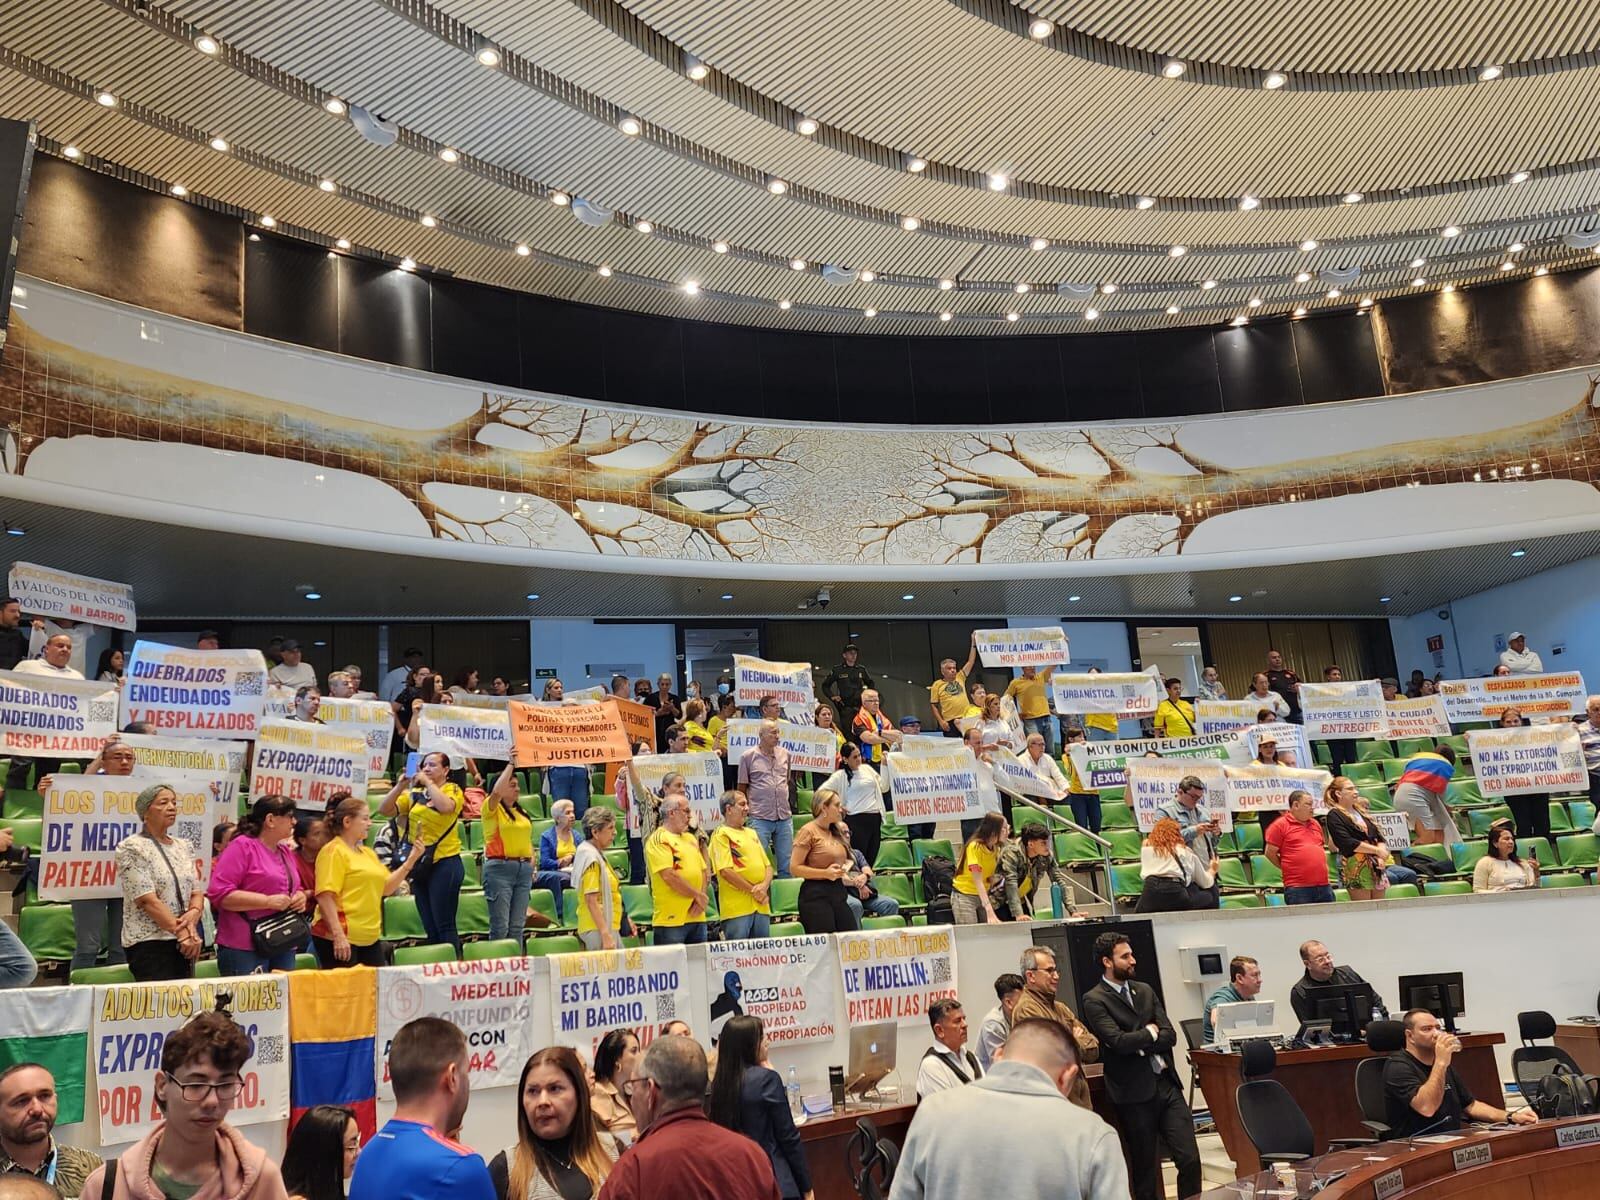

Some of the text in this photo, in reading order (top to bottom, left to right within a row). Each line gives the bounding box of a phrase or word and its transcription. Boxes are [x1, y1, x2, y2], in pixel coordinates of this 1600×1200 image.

[12, 580, 67, 597] AVALÚOS
[69, 589, 91, 602] DEL
[93, 594, 116, 607] AÑO
[69, 604, 82, 615] MI
[86, 608, 128, 624] BARRIO.
[130, 684, 231, 706] ENDEUDADOS
[1126, 696, 1150, 709] edu
[518, 724, 563, 734] MORADORES
[572, 723, 617, 734] FUNDADORES
[730, 736, 742, 746] LA
[779, 742, 809, 753] ONJA:
[1087, 744, 1112, 756] MUY
[1115, 741, 1158, 754] BONITO
[1162, 739, 1176, 750] EL
[1179, 732, 1239, 748] DISCURSO
[218, 755, 227, 770] A
[547, 748, 604, 760] JUSTICIA
[1479, 752, 1490, 763] NO
[1515, 745, 1558, 760] EXTORSIÓN
[257, 749, 353, 778] EXPROPIADOS
[1482, 765, 1498, 777] CON
[290, 778, 303, 799] EL
[693, 783, 716, 801] DE LA
[893, 775, 929, 794] NUESTROS
[929, 773, 972, 792] PATRIMONIOS
[1137, 781, 1166, 794] NO MÁS
[1266, 779, 1281, 788] LOS
[1484, 776, 1532, 792] FICO AHORA
[50, 790, 95, 815] LOS
[896, 799, 931, 817] NUESTROS
[1139, 797, 1154, 809] CON
[1239, 795, 1263, 808] que
[47, 823, 74, 852] DE
[42, 861, 117, 888] PATEAN
[710, 935, 827, 952] METRO LIGERO DE LA 80
[841, 931, 950, 962] LOS POLÍTICOS
[423, 958, 530, 977] LA LONJA DE
[790, 954, 807, 964] DE:
[844, 958, 930, 993] DE MEDELLÍN:
[451, 976, 531, 1001] MEDELLÍN
[561, 971, 679, 1004] ESTÁ ROBANDO
[745, 986, 803, 1002] ROBO A LA
[101, 985, 193, 1022] ADULTOS
[747, 1000, 807, 1016] PROPIEDAD
[849, 993, 920, 1023] PATEAN LAS
[561, 1010, 579, 1031] MI
[762, 1015, 797, 1029] IVADA
[469, 1029, 506, 1046] CON
[766, 1022, 834, 1042] XPROPIACIÓN
[99, 1085, 142, 1127] POR
